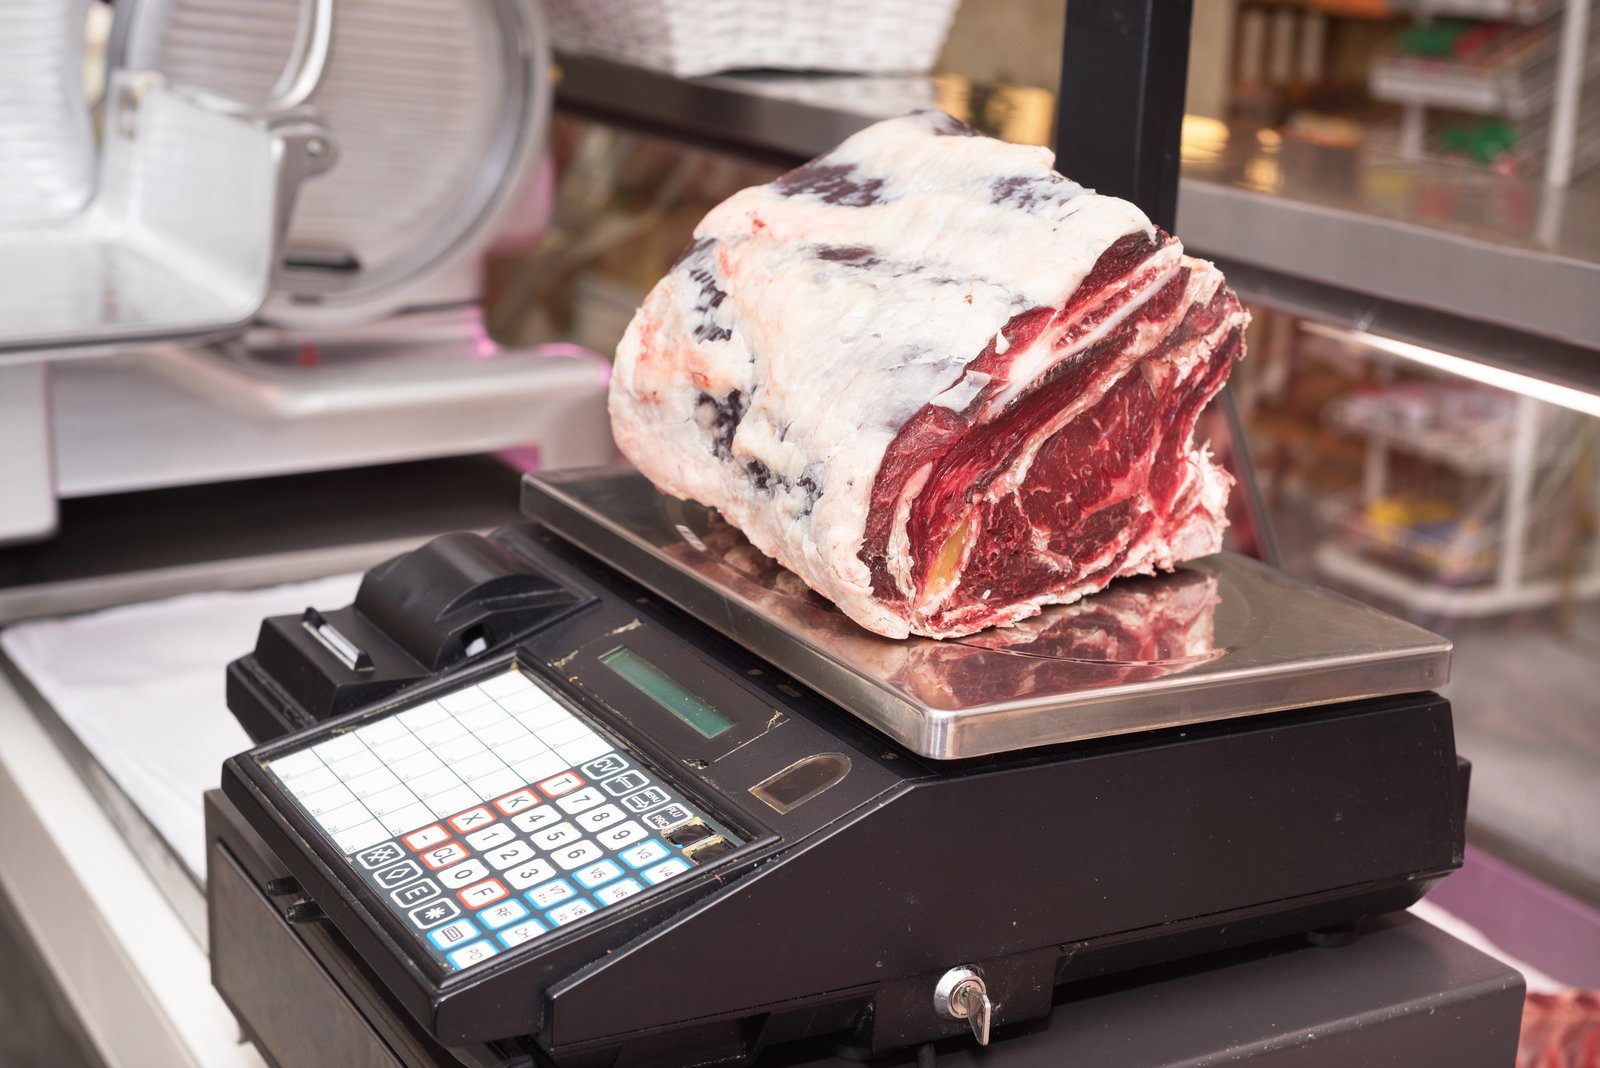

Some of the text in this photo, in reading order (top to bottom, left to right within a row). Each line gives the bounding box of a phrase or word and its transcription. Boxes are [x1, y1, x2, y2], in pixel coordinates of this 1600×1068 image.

[594, 758, 619, 773] CV
[553, 777, 573, 788] T
[507, 796, 529, 808] K
[572, 795, 591, 805] 7
[592, 812, 610, 822] 8
[665, 805, 684, 818] PLU
[461, 812, 484, 825] X
[528, 814, 545, 824] 4
[651, 814, 670, 828] PRC
[482, 832, 500, 841] 1
[546, 831, 566, 842] 5
[612, 829, 631, 840] 9
[432, 847, 457, 864] CL
[500, 849, 519, 860] 2
[567, 849, 587, 860] 6
[637, 848, 652, 860] V3
[520, 868, 539, 879] 3
[590, 867, 606, 879] V5
[658, 866, 674, 877] V4
[404, 885, 429, 901] E
[472, 886, 495, 897] F
[549, 885, 566, 895] V7
[612, 887, 628, 898] V6
[494, 906, 512, 918] RF
[571, 904, 586, 916] V8
[515, 927, 532, 940] CH
